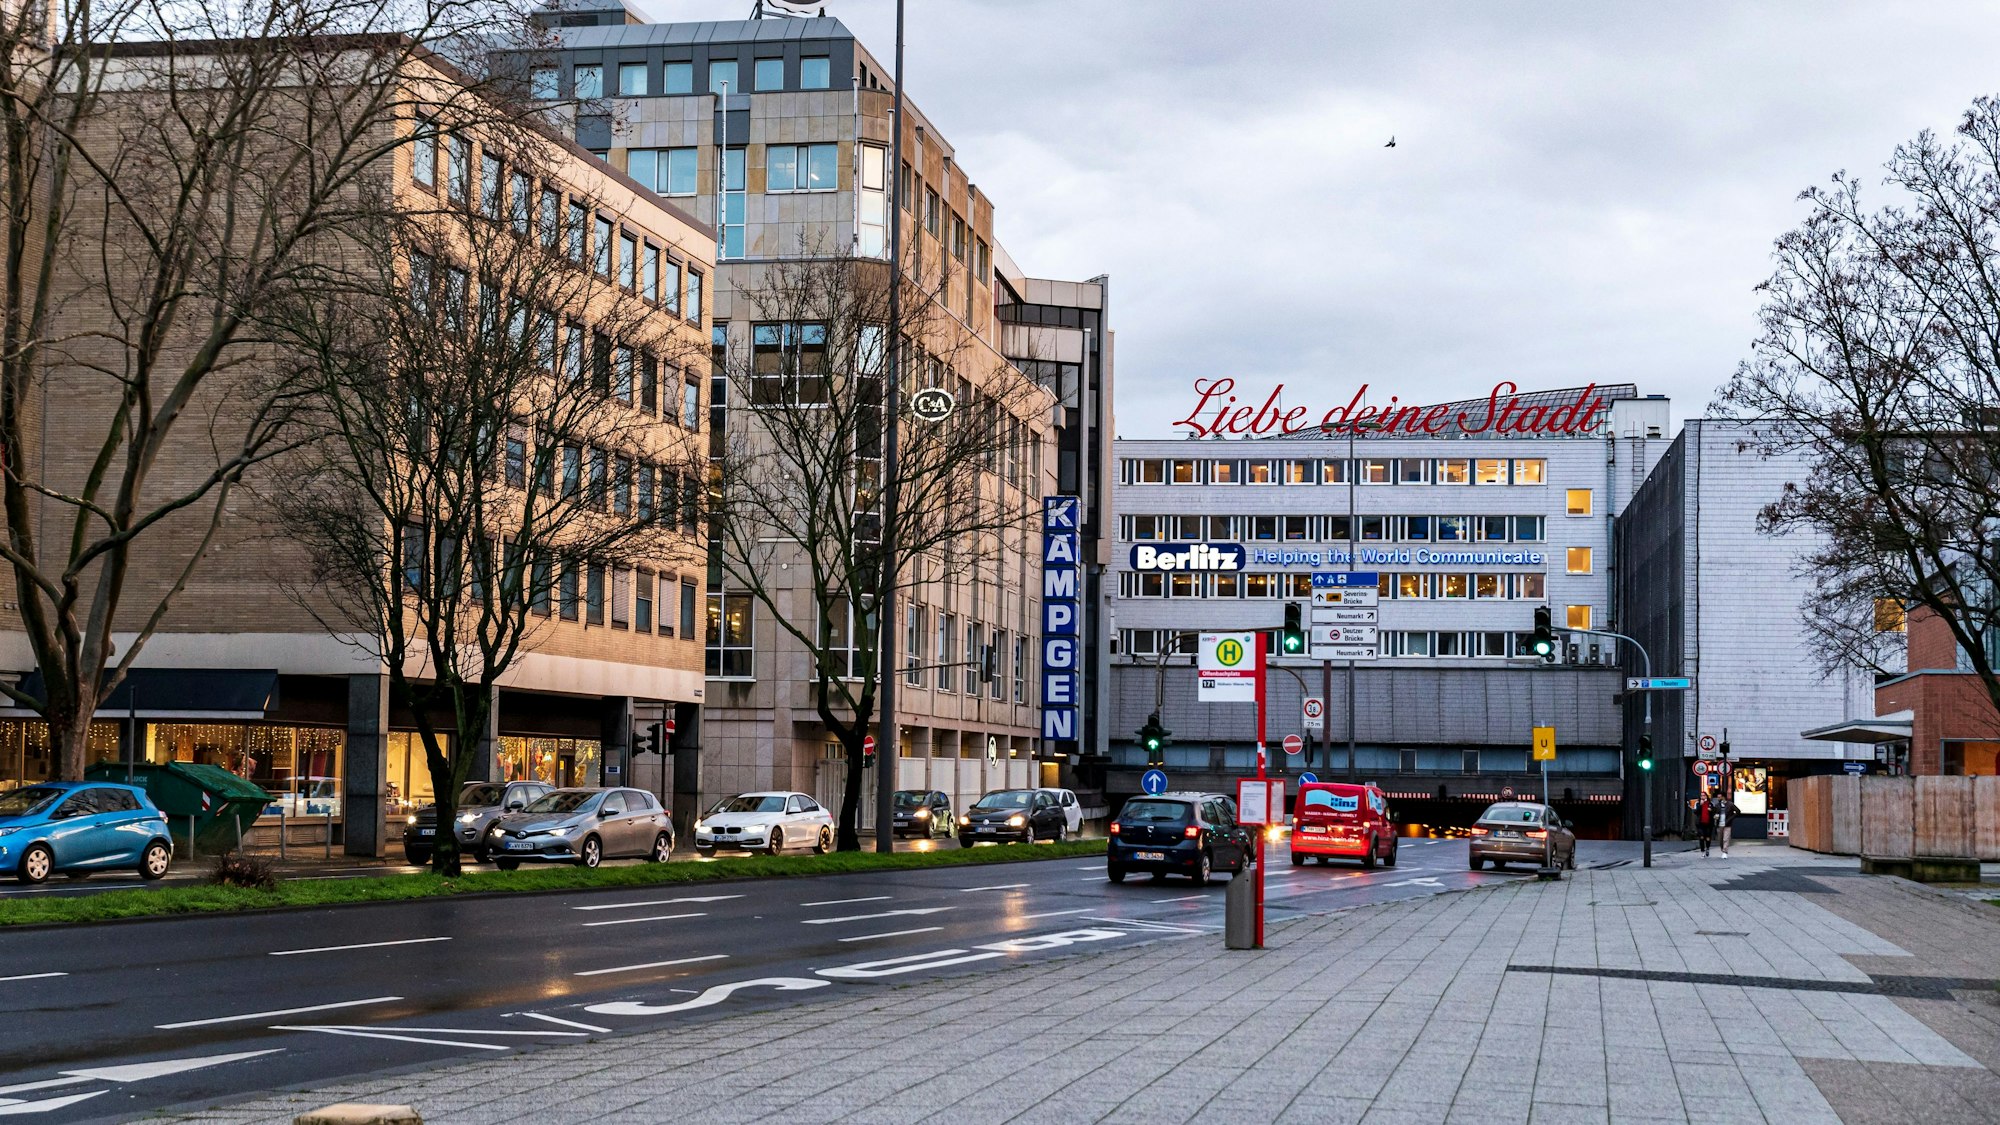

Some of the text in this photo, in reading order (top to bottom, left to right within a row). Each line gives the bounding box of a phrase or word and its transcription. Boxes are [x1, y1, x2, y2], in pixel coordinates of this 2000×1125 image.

[918, 396, 948, 412] C&A
[1173, 378, 1606, 437] Liebe deine Stadt
[1137, 544, 1238, 570] Berlitz
[1254, 549, 1541, 567] Helping the World Communicate
[1045, 499, 1074, 738] KÄMPGEN
[1223, 644, 1236, 661] H
[1203, 680, 1214, 688] 171
[1541, 739, 1548, 748] U
